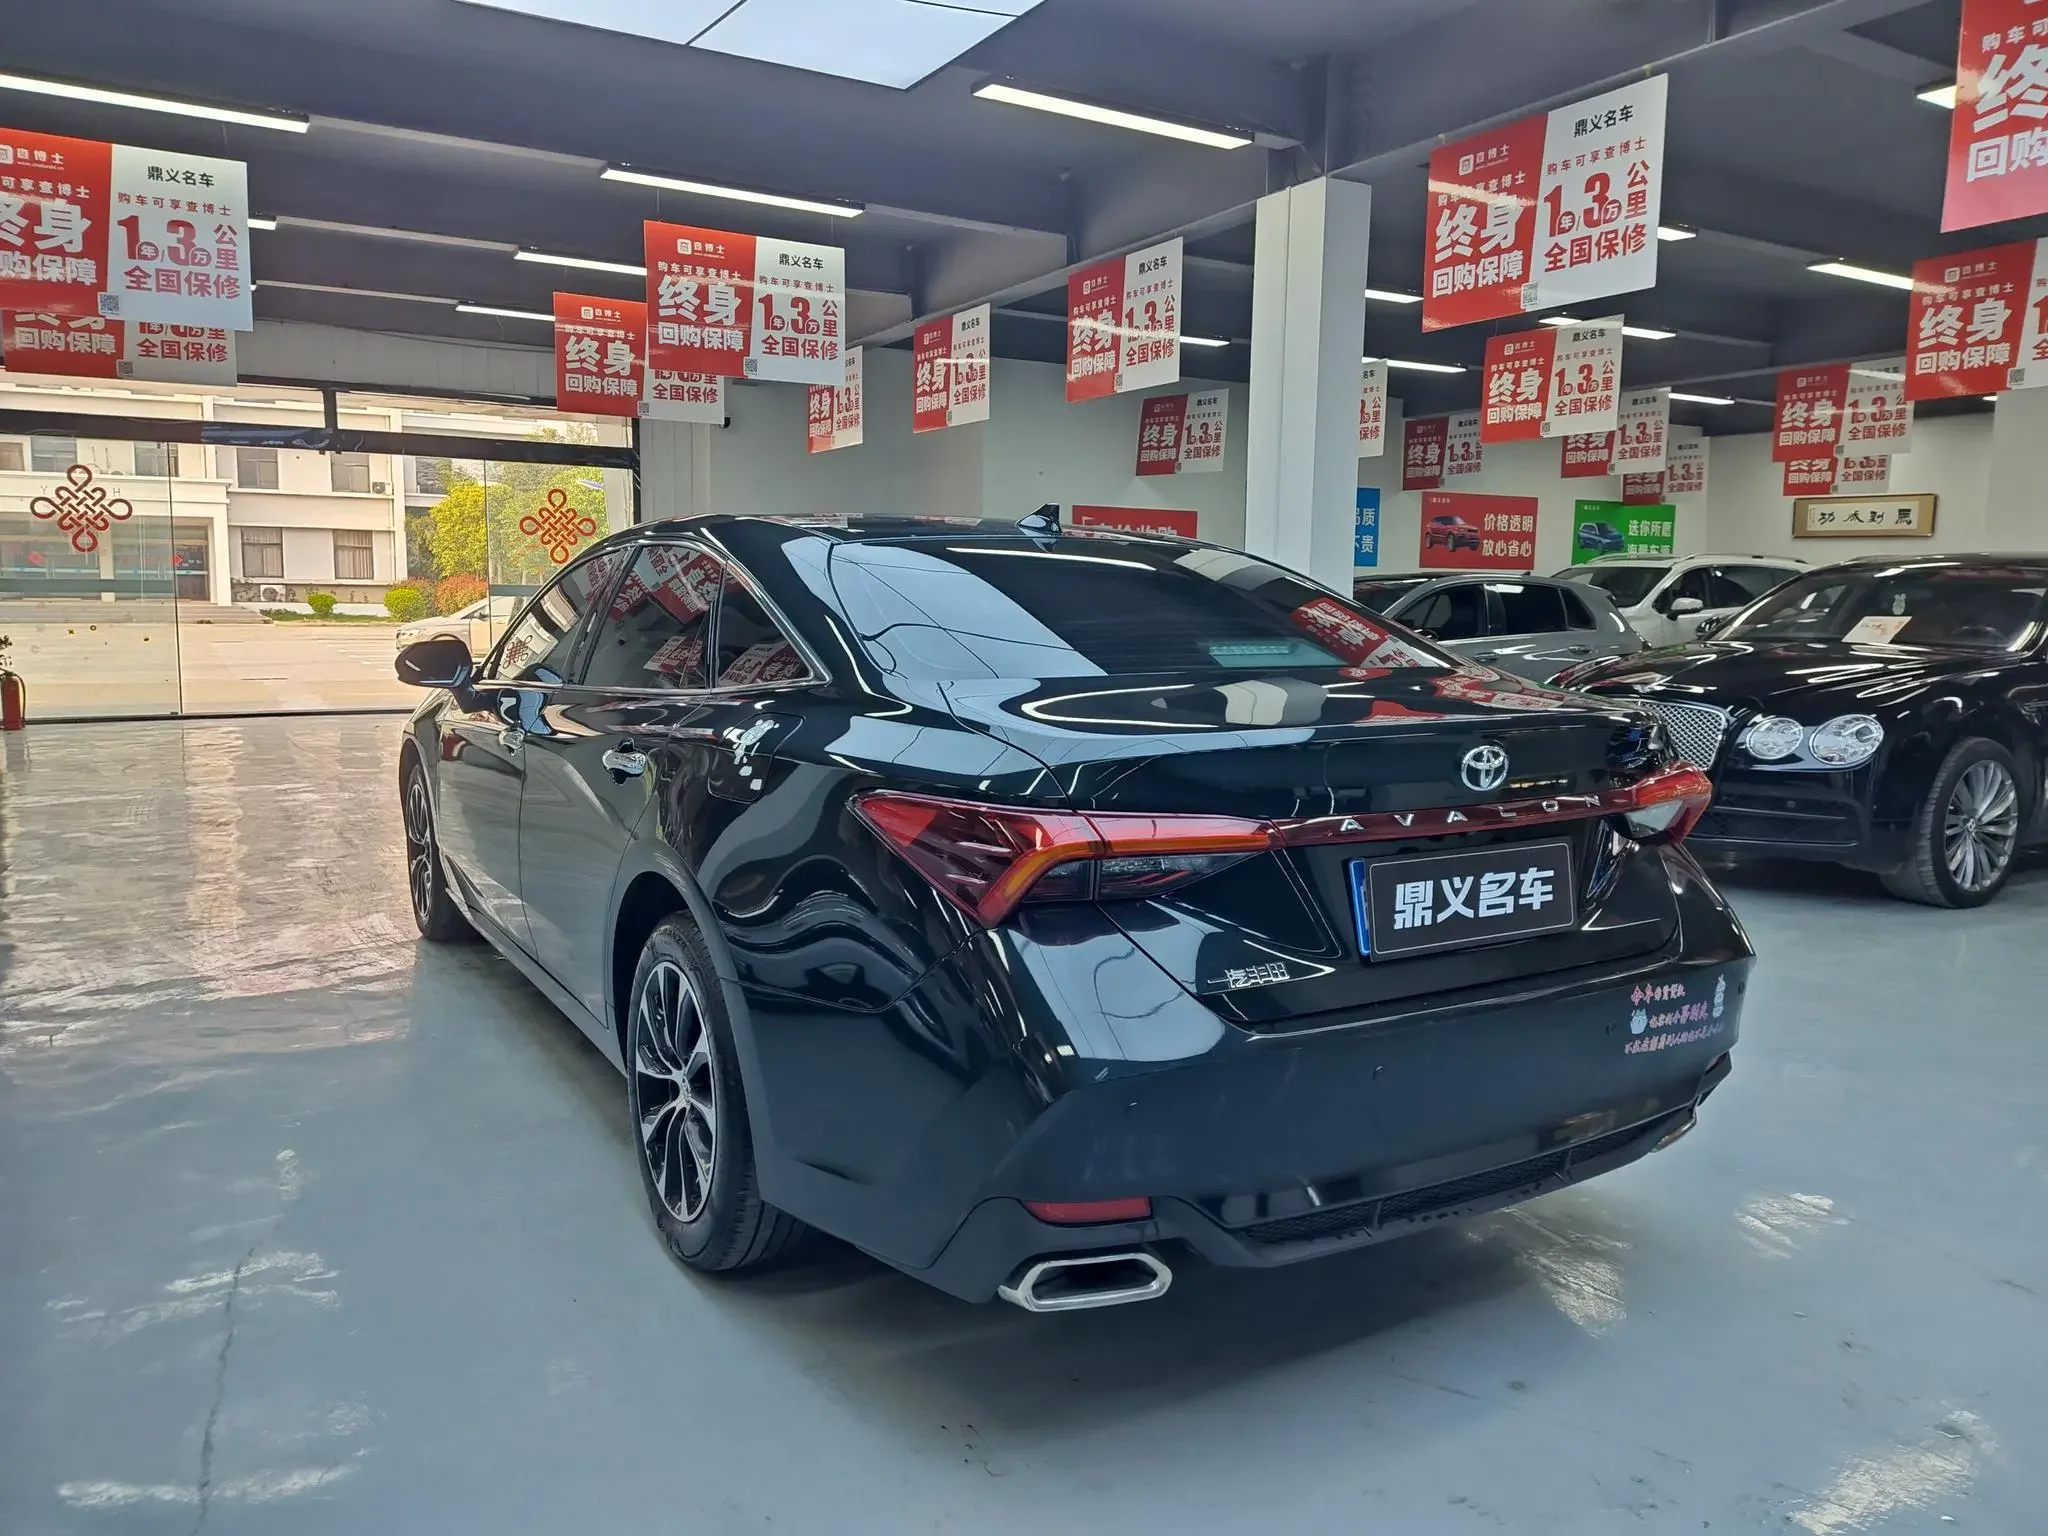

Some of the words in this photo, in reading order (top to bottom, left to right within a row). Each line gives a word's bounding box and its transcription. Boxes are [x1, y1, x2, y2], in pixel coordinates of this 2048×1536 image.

[1573, 104, 1634, 138] 鼎义名车
[1547, 137, 1647, 176] 购车可享查博士
[147, 166, 214, 188] 鼎义名车
[117, 191, 231, 217] 购车可享查博士
[1435, 193, 1523, 264] 终身
[1544, 223, 1647, 273] 全国保修
[657, 260, 743, 282] 购车可享查博士
[778, 253, 824, 271] 鼎义名车
[1138, 256, 1167, 275] 鼎义名车
[1432, 249, 1523, 298] 回购保障
[123, 265, 240, 300] 全国保修
[758, 275, 835, 294] 购车可享查博士
[657, 275, 742, 327] 终身
[1072, 309, 1116, 355] 终身
[1572, 328, 1607, 343] 鼎义名车
[1918, 297, 2013, 350] 终身
[14, 327, 116, 355] 回购保障
[657, 321, 744, 353] 回购保障
[761, 335, 839, 362] 全国保修
[137, 338, 228, 364] 全国保修
[564, 335, 636, 377] 终身
[1071, 350, 1116, 378] 回购保障
[1126, 338, 1174, 367] 全国保修
[1915, 341, 2011, 376] 回购保障
[564, 373, 638, 398] 回购保障
[916, 357, 947, 394] 终身
[1488, 367, 1543, 405] 终身
[653, 383, 718, 404] 全国保修
[810, 390, 831, 420] 终身
[916, 391, 947, 414] 回购保障
[954, 384, 986, 405] 全国保修
[1554, 394, 1613, 416] 全国保修
[1487, 402, 1542, 425] 回购保障
[1781, 399, 1836, 429] 终身
[1142, 422, 1177, 448] 终身
[1779, 427, 1836, 446] 回购保障
[1848, 422, 1906, 441] 全国保修
[1141, 447, 1176, 462] 回购保障
[1184, 445, 1221, 459] 全国保修
[1407, 442, 1441, 465] 终身
[1565, 449, 1609, 464] 回购保障
[1618, 445, 1662, 460] 全国保修
[1841, 469, 1886, 482] 全国保修
[1483, 512, 1533, 533] 价格透明
[1481, 538, 1532, 558] 放心省心
[1340, 795, 1601, 832] AVALON
[1393, 867, 1555, 930] 鼎义名车
